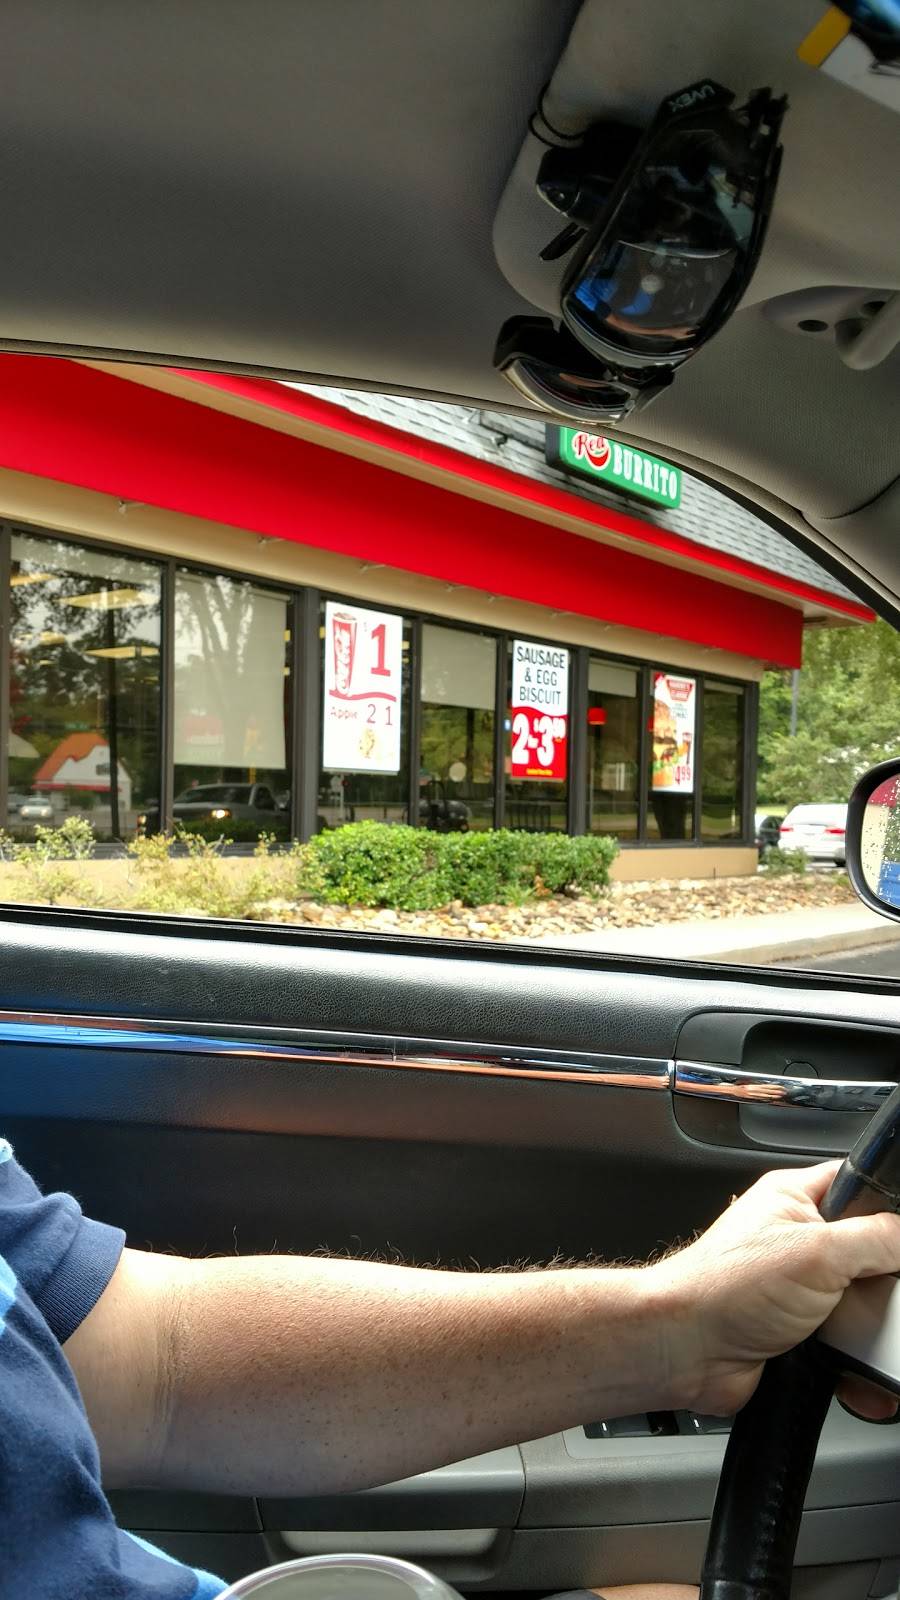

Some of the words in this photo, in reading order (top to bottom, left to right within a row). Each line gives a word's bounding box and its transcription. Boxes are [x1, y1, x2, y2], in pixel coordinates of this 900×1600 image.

[572, 432, 608, 459] Red
[613, 444, 677, 500] BURRITO
[516, 646, 566, 669] SAUSAGE
[524, 667, 531, 682] &
[536, 669, 557, 686] EGG
[519, 686, 561, 705] BISCUIT
[367, 703, 376, 724] 2
[511, 713, 530, 765] 2
